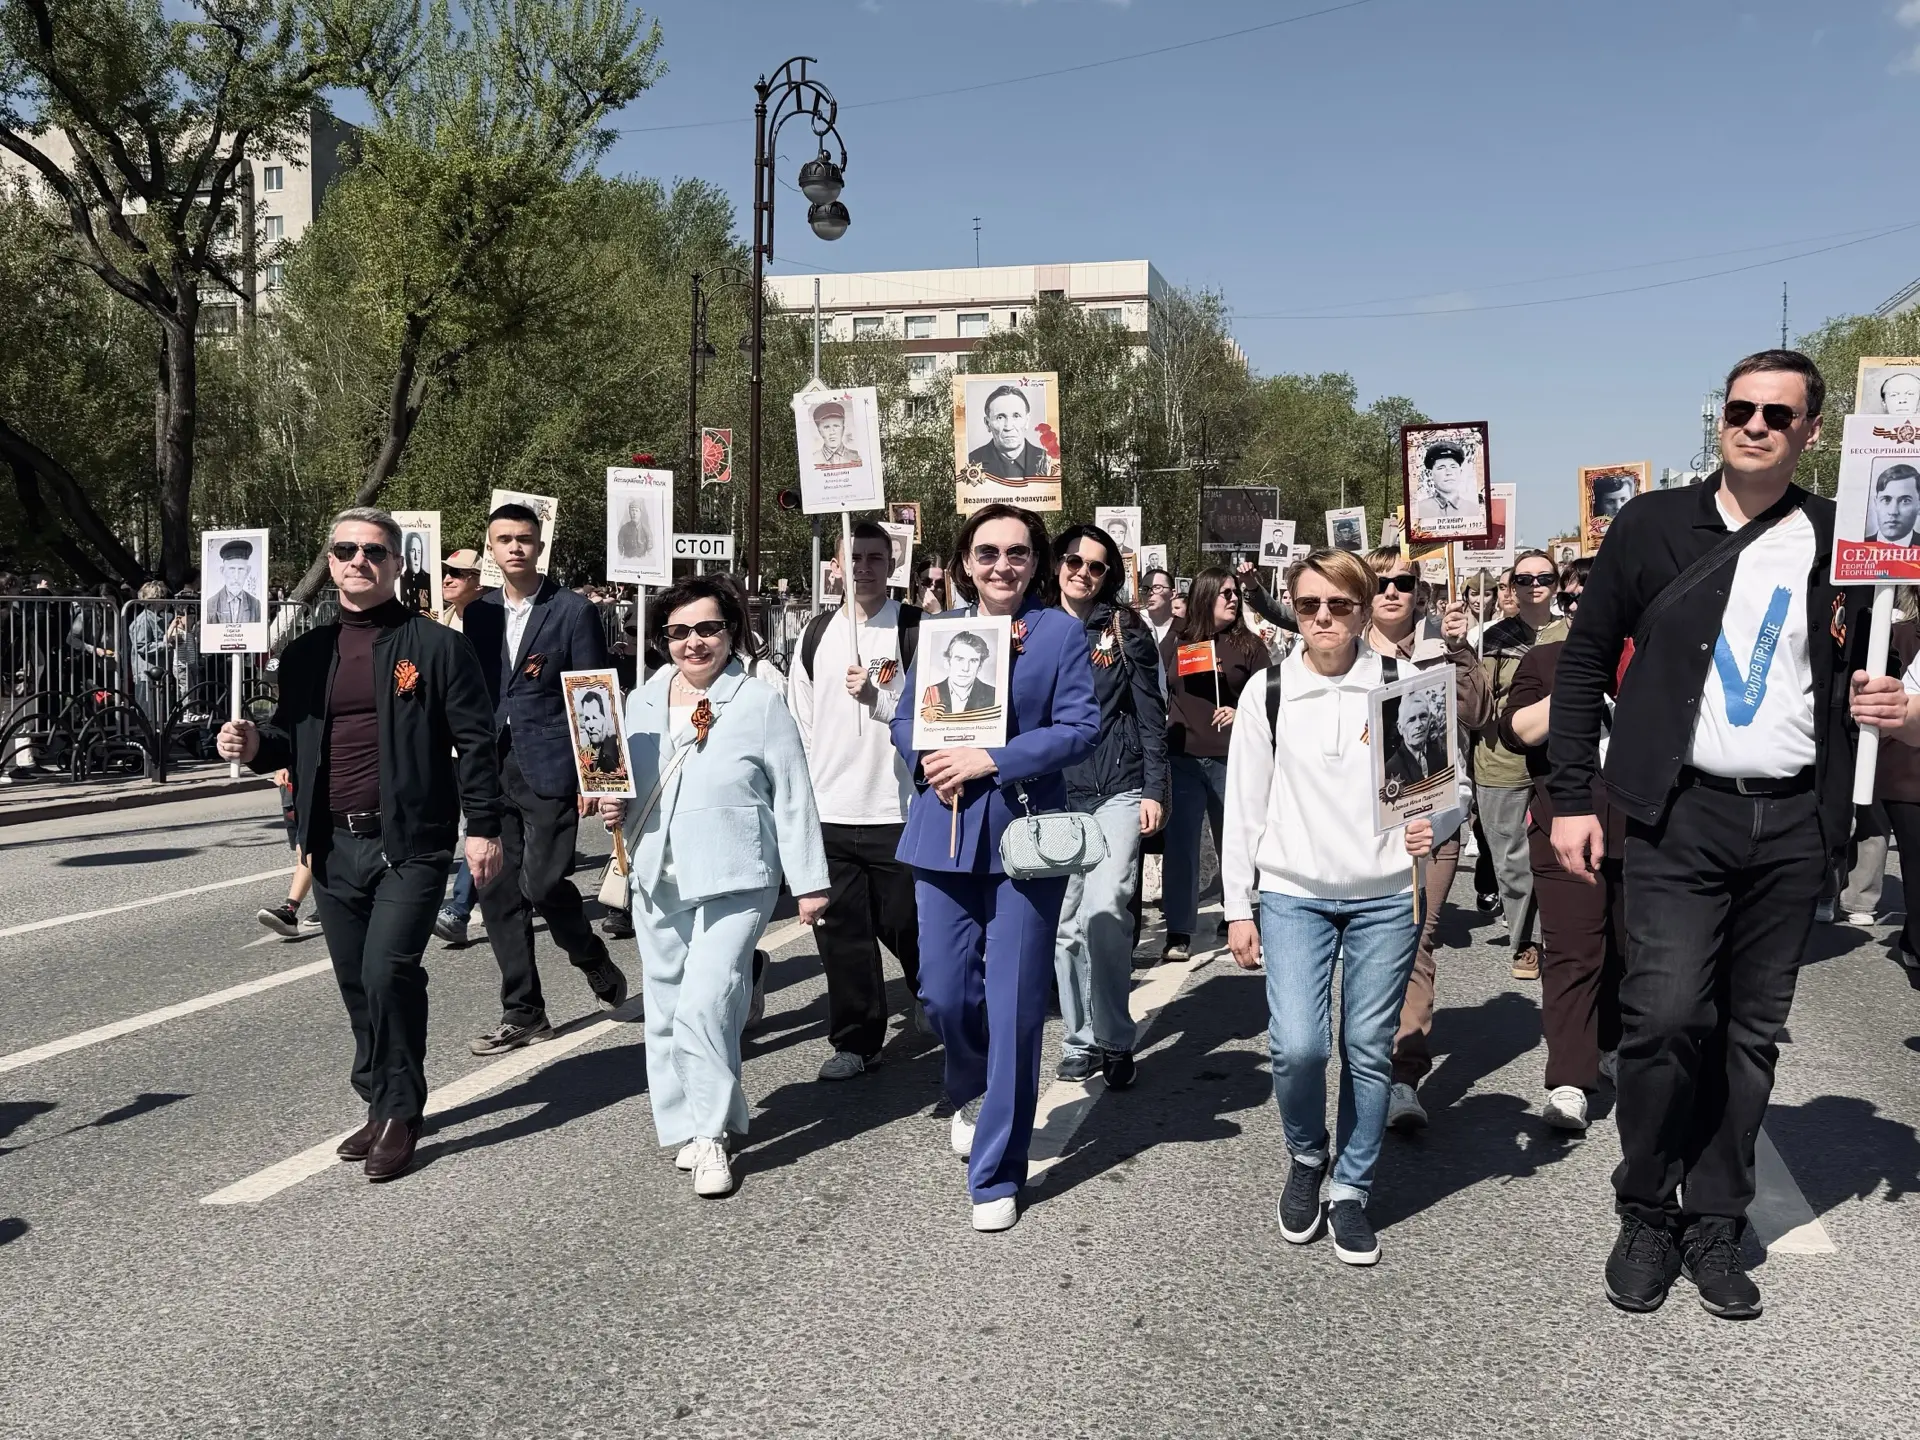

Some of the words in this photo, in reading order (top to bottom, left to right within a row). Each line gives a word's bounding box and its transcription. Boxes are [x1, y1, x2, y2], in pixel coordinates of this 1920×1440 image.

[1850, 446, 1906, 455] БЕССМЕРТНЫЙ
[675, 538, 725, 555] СТОП
[1842, 549, 1920, 565] СЕДИНИ
[1754, 622, 1780, 664] ПРАВДЕ
